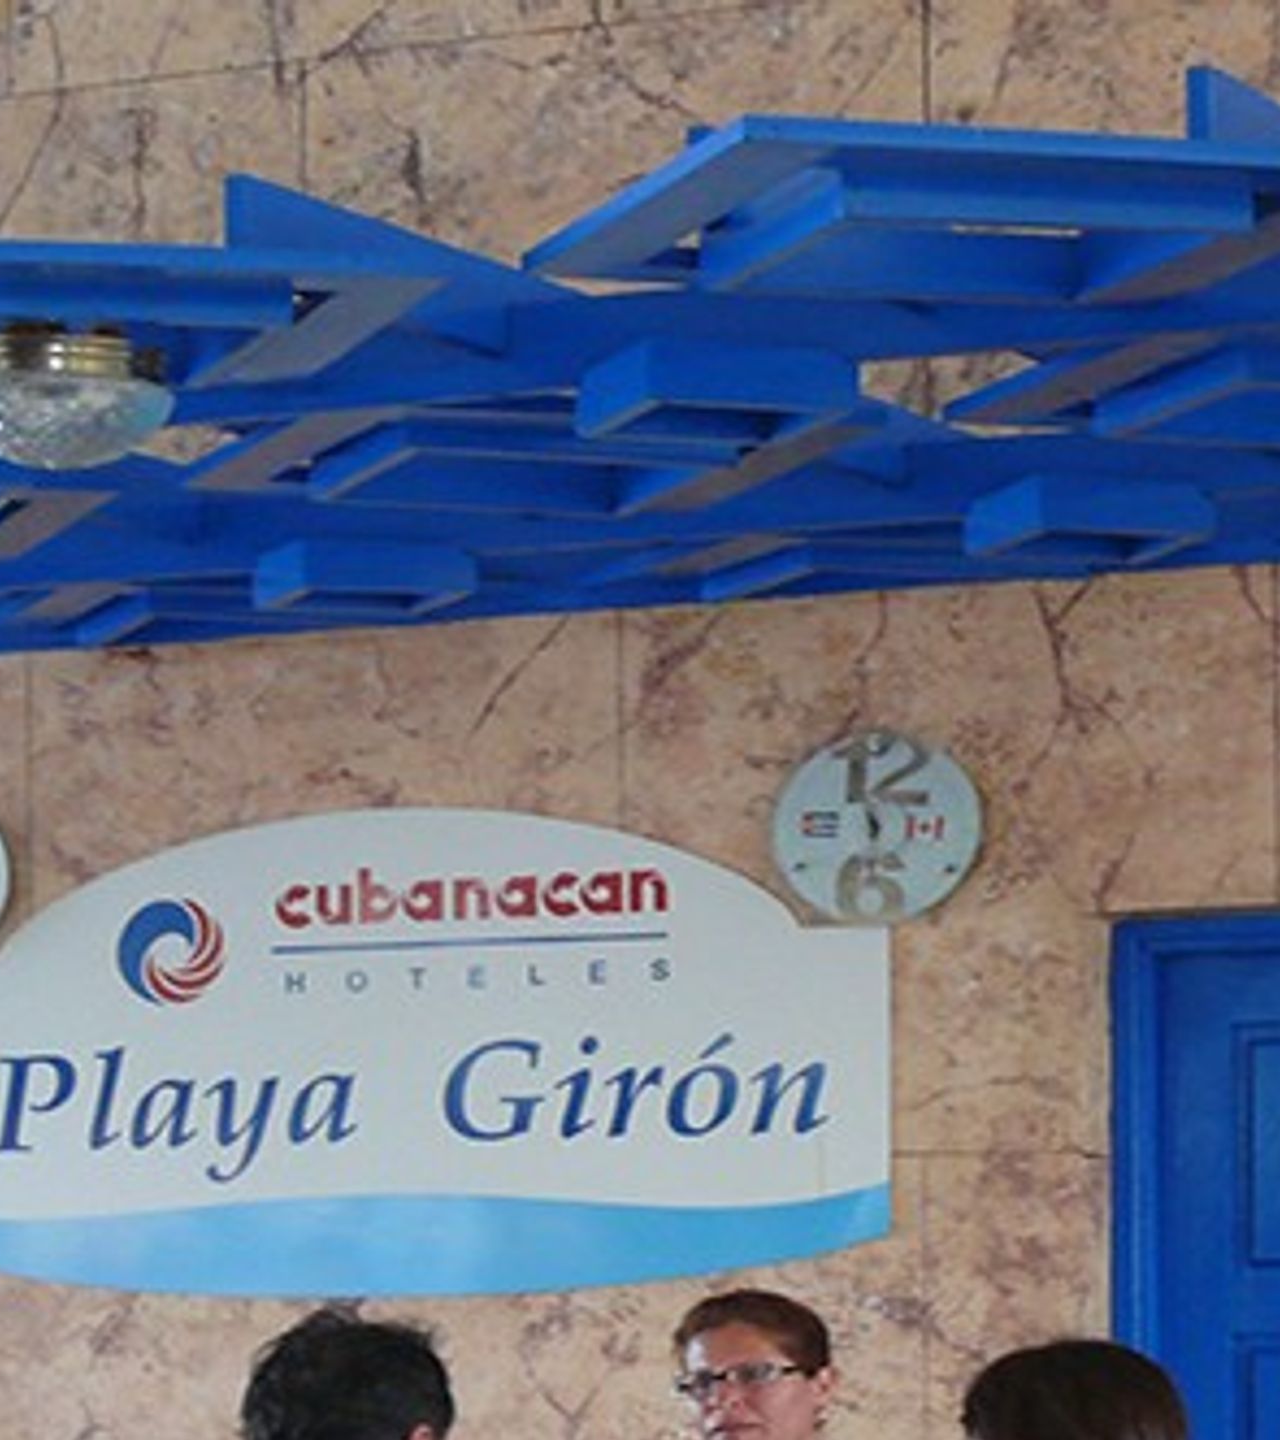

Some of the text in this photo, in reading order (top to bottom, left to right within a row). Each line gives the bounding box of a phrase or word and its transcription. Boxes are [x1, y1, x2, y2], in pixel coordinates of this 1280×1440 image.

[831, 729, 930, 804] 12
[274, 867, 670, 929] cubanacan
[835, 852, 907, 919] 6
[442, 1032, 830, 1142] Girón
